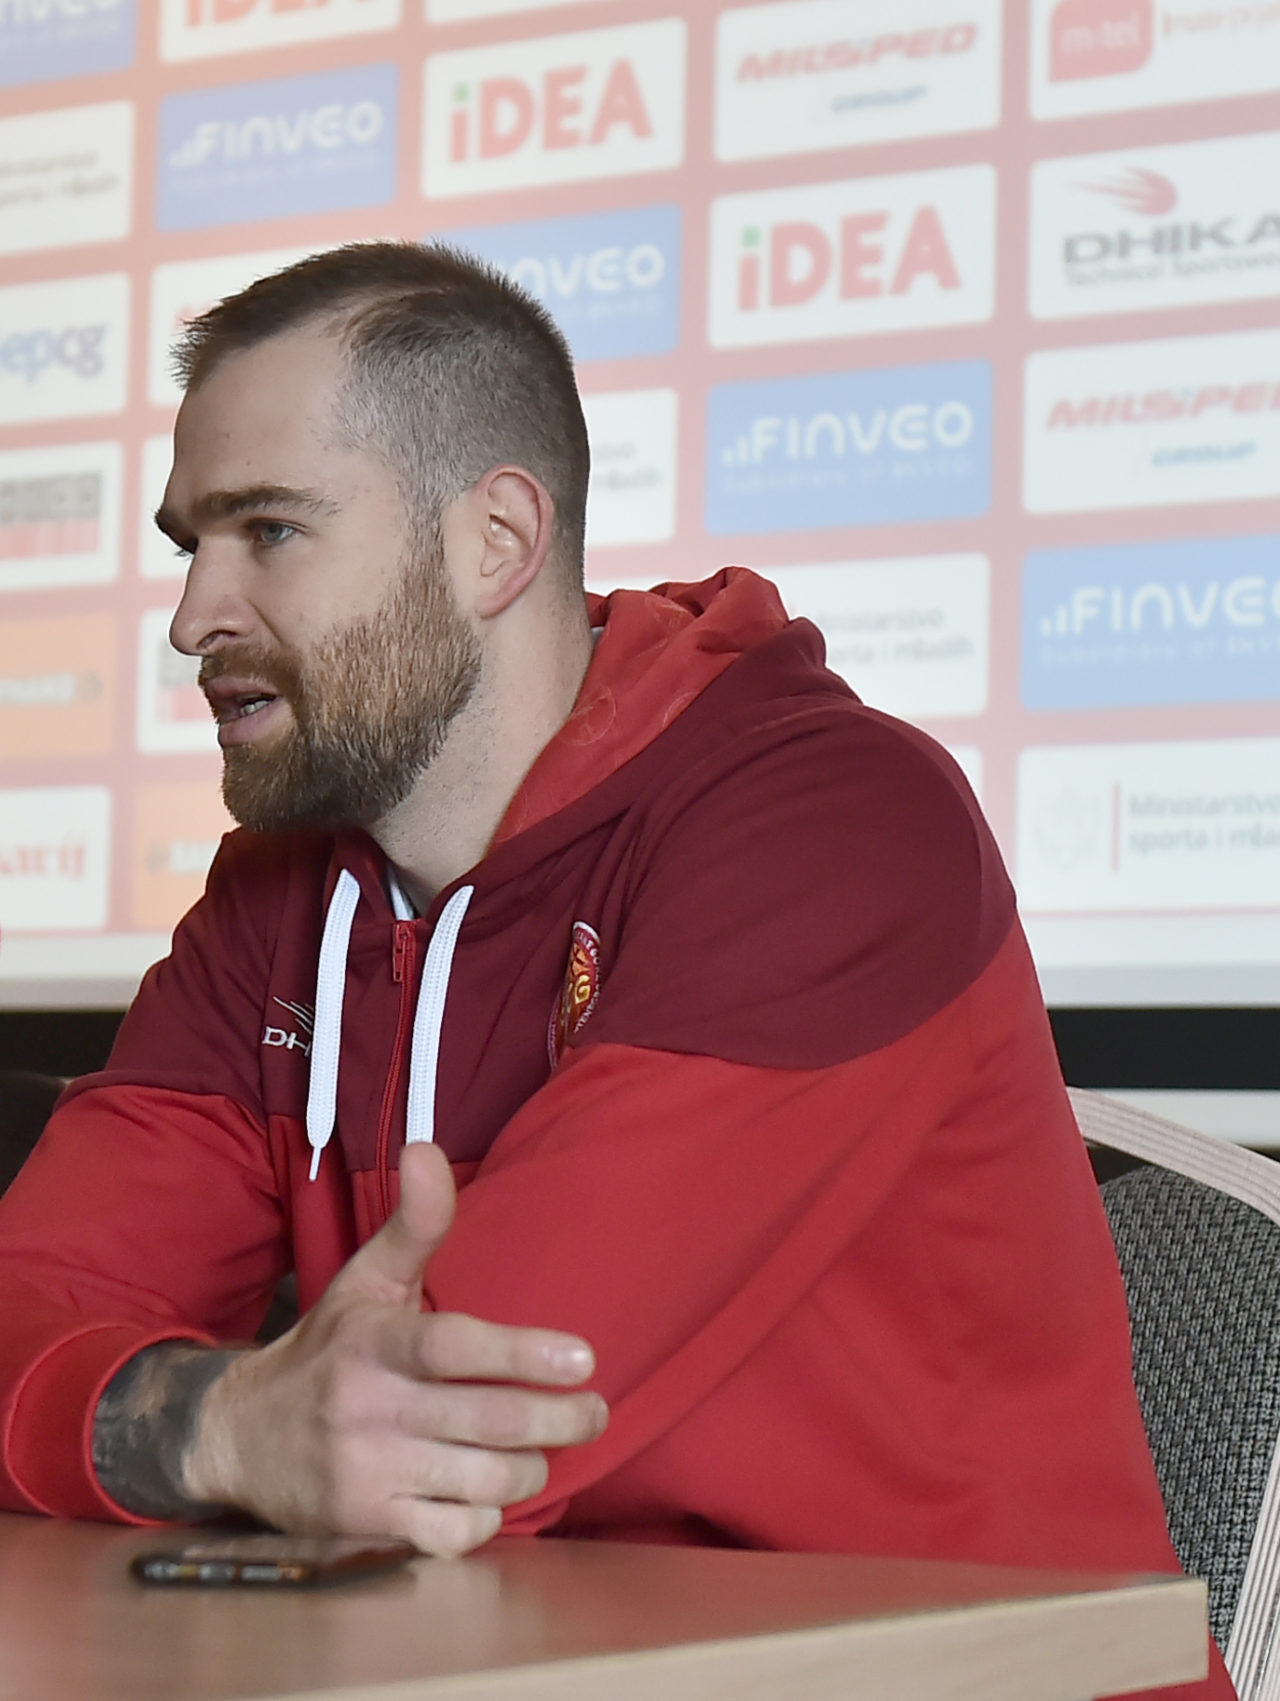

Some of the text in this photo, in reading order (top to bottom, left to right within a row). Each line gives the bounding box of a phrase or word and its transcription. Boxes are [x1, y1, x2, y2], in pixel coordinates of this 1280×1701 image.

[512, 243, 666, 300] NVEO
[750, 400, 974, 465] FINVEO
[1042, 381, 1280, 434] MILSPE
[1072, 575, 1280, 637] FINVE
